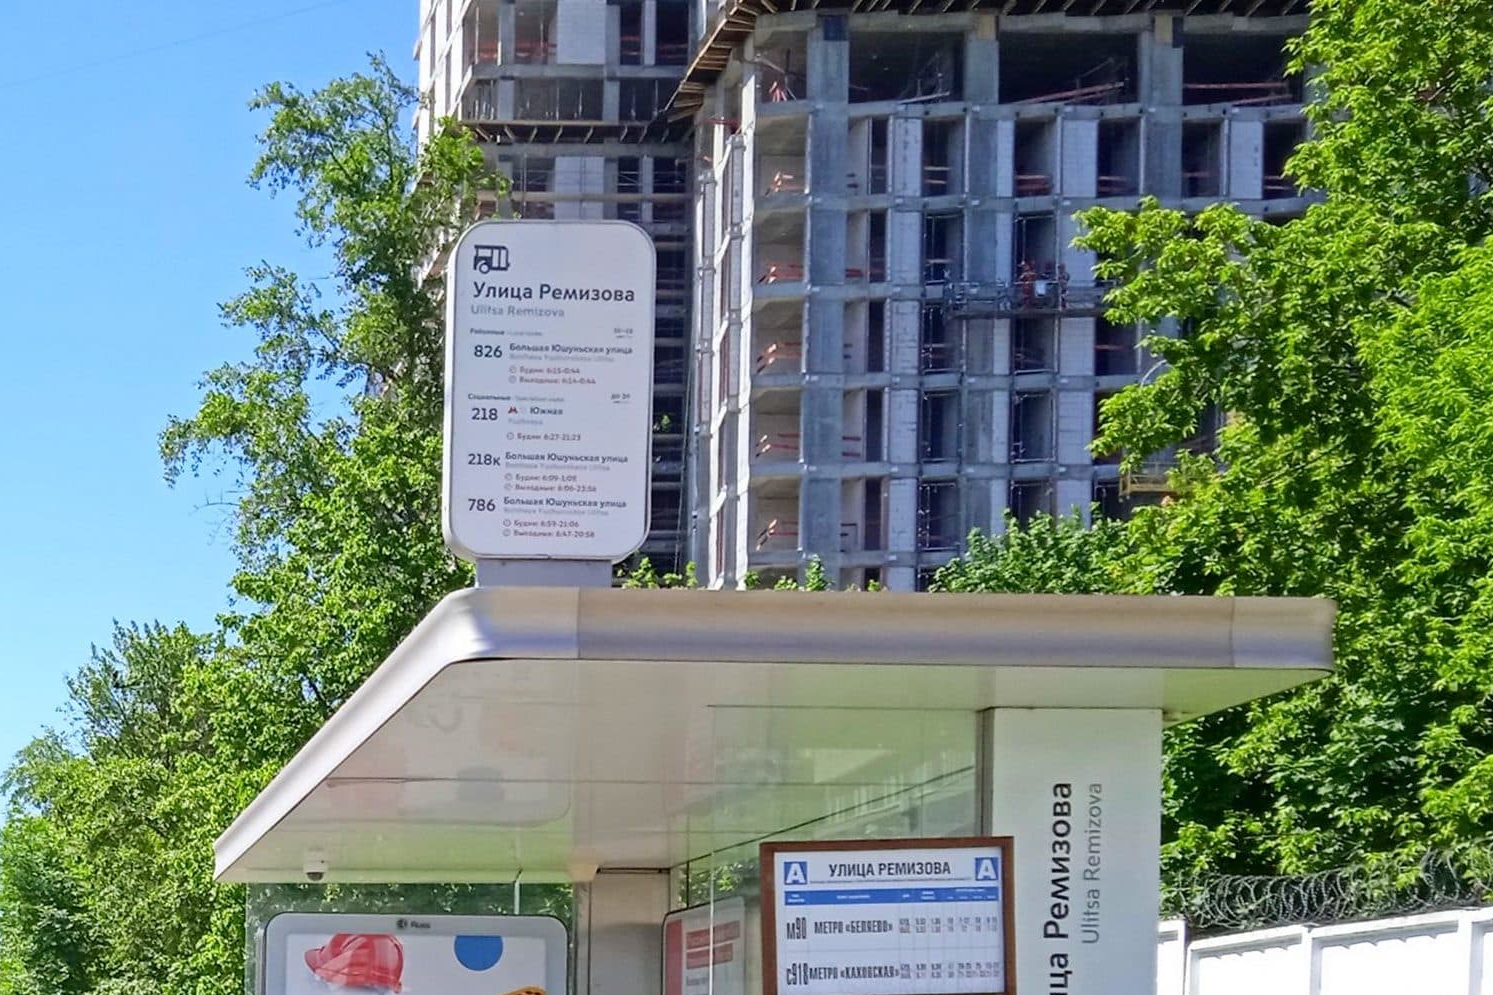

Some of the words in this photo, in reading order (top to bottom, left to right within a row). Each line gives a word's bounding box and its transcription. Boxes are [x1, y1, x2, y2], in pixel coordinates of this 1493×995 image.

[473, 281, 533, 300] Улица
[539, 283, 635, 302] Ремизова
[470, 305, 504, 316] Ulitsa
[508, 305, 565, 318] Remizova
[474, 344, 503, 359] 826
[509, 342, 549, 353] Большая
[606, 346, 633, 355] улица
[471, 407, 498, 421] 218
[529, 406, 563, 416] Южная
[468, 452, 501, 467] 218к
[505, 451, 545, 462] Большая
[600, 455, 628, 464] улица
[468, 498, 496, 512] 786
[503, 496, 543, 506] Большая
[599, 500, 627, 509] улица
[1083, 783, 1103, 881] Remizova
[1043, 782, 1072, 939] Ремизова
[829, 863, 875, 878] УЛИЦА
[878, 861, 952, 876] РЕМИЗОВА
[1081, 888, 1101, 944] Ulitsa
[814, 921, 843, 934] МЕТРО
[809, 966, 839, 980] МЕТРО
